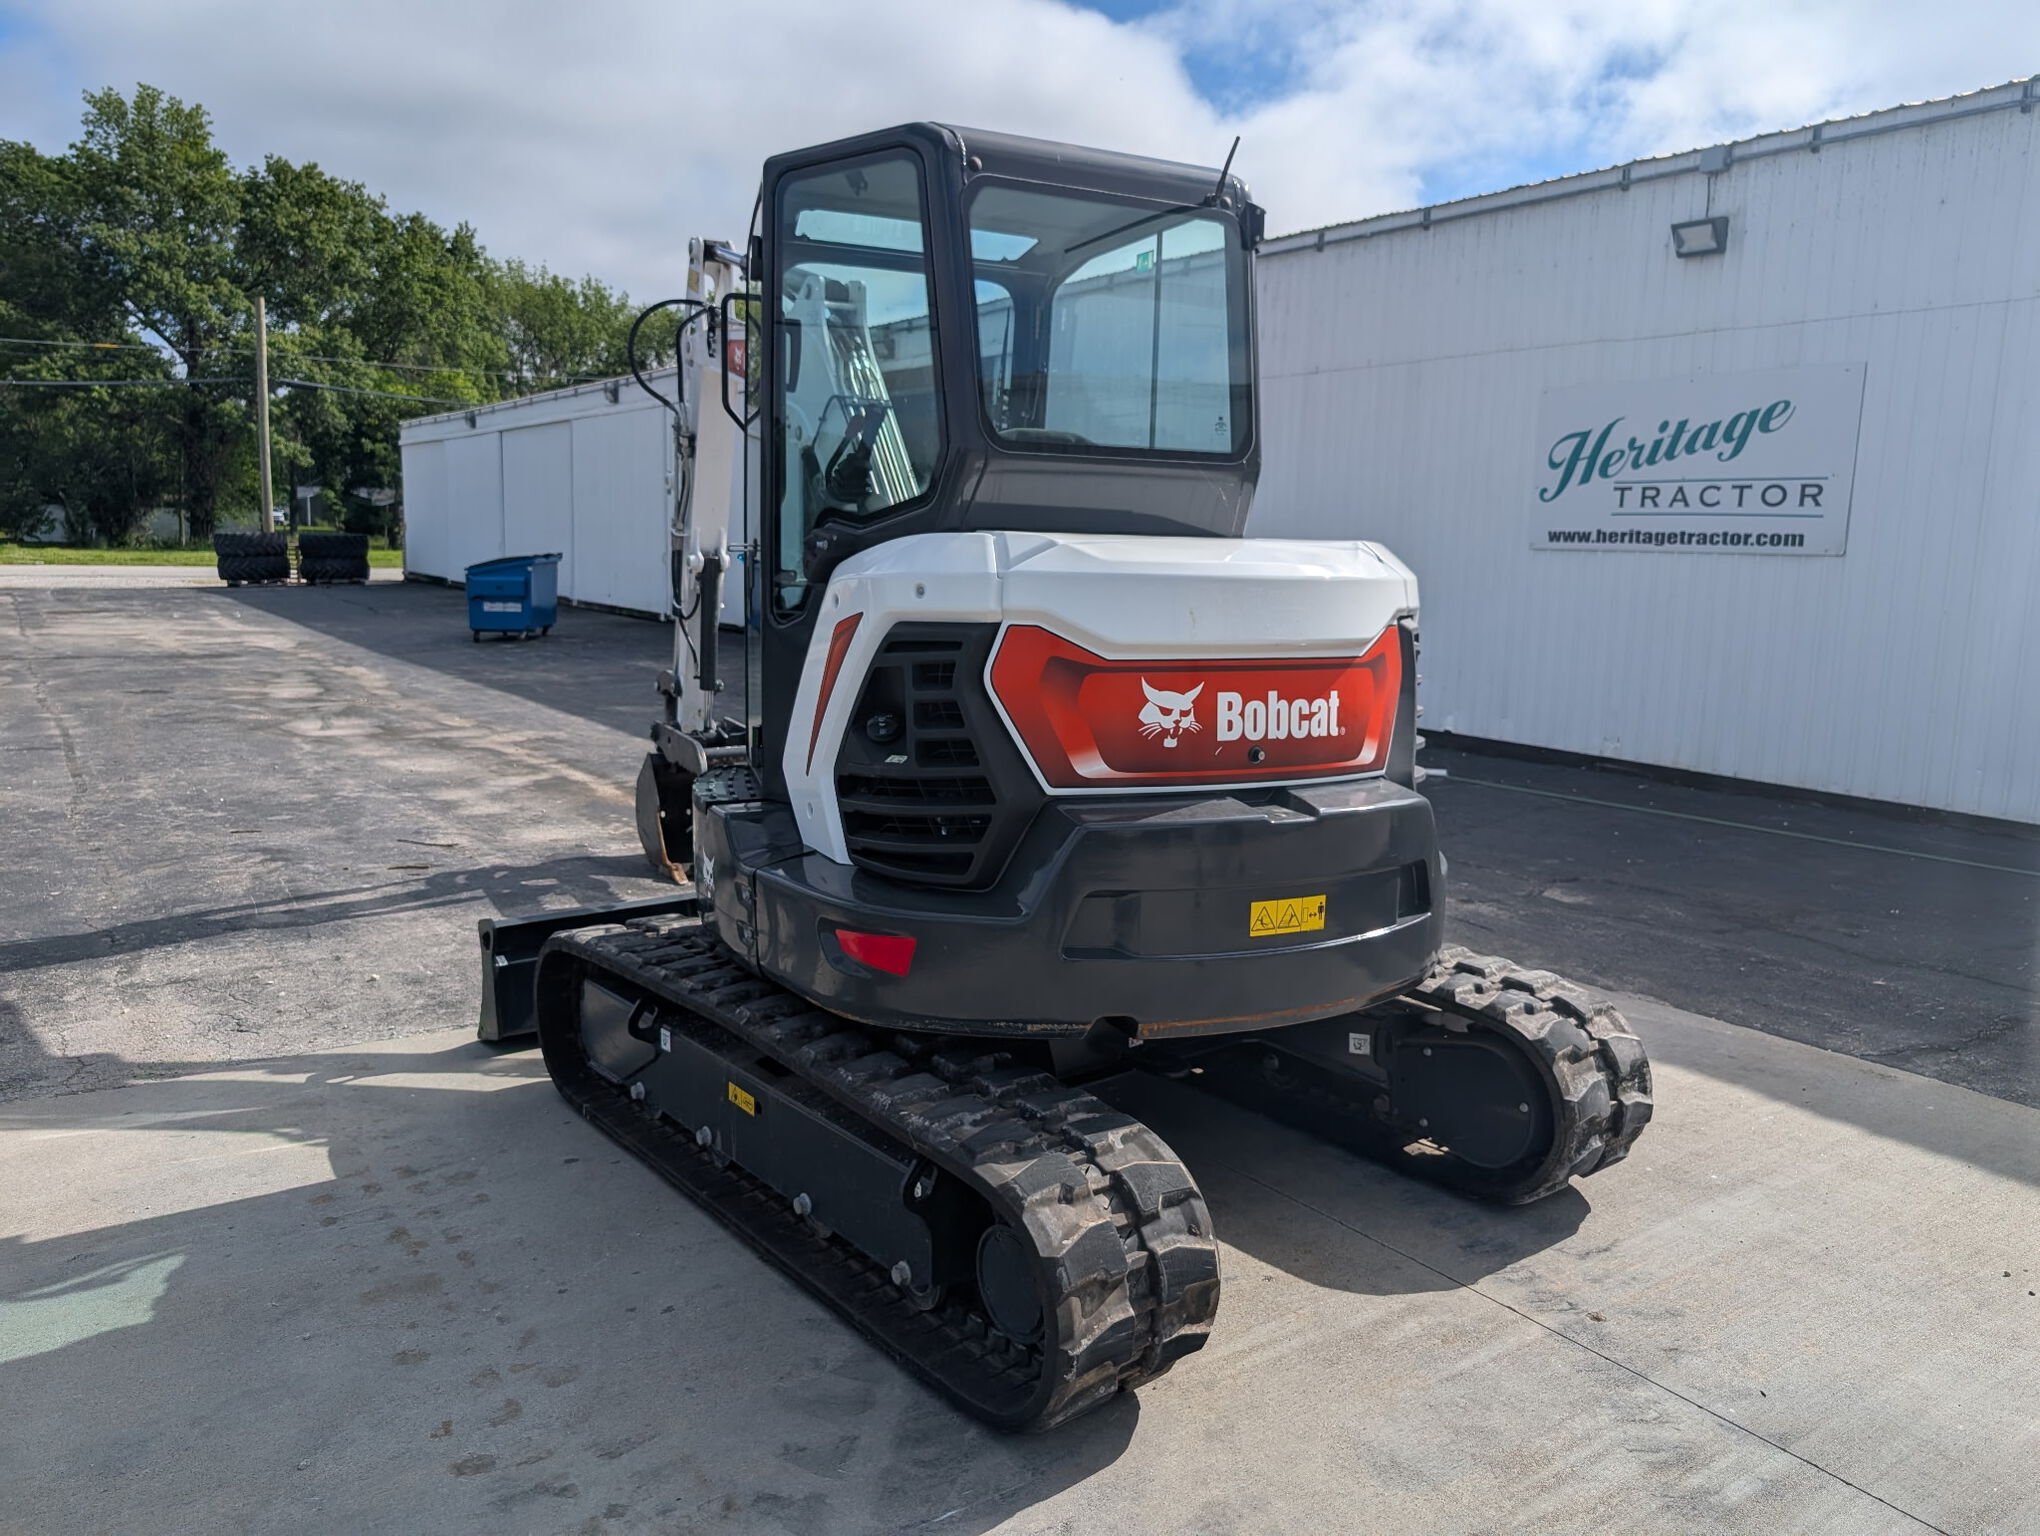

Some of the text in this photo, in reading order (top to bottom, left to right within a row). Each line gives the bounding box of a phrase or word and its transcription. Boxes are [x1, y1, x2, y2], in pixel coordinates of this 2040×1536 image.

[1539, 399, 1796, 503] Heritage
[1612, 483, 1824, 508] TRACTOR
[1548, 528, 1805, 548] www.heritagetractor.com
